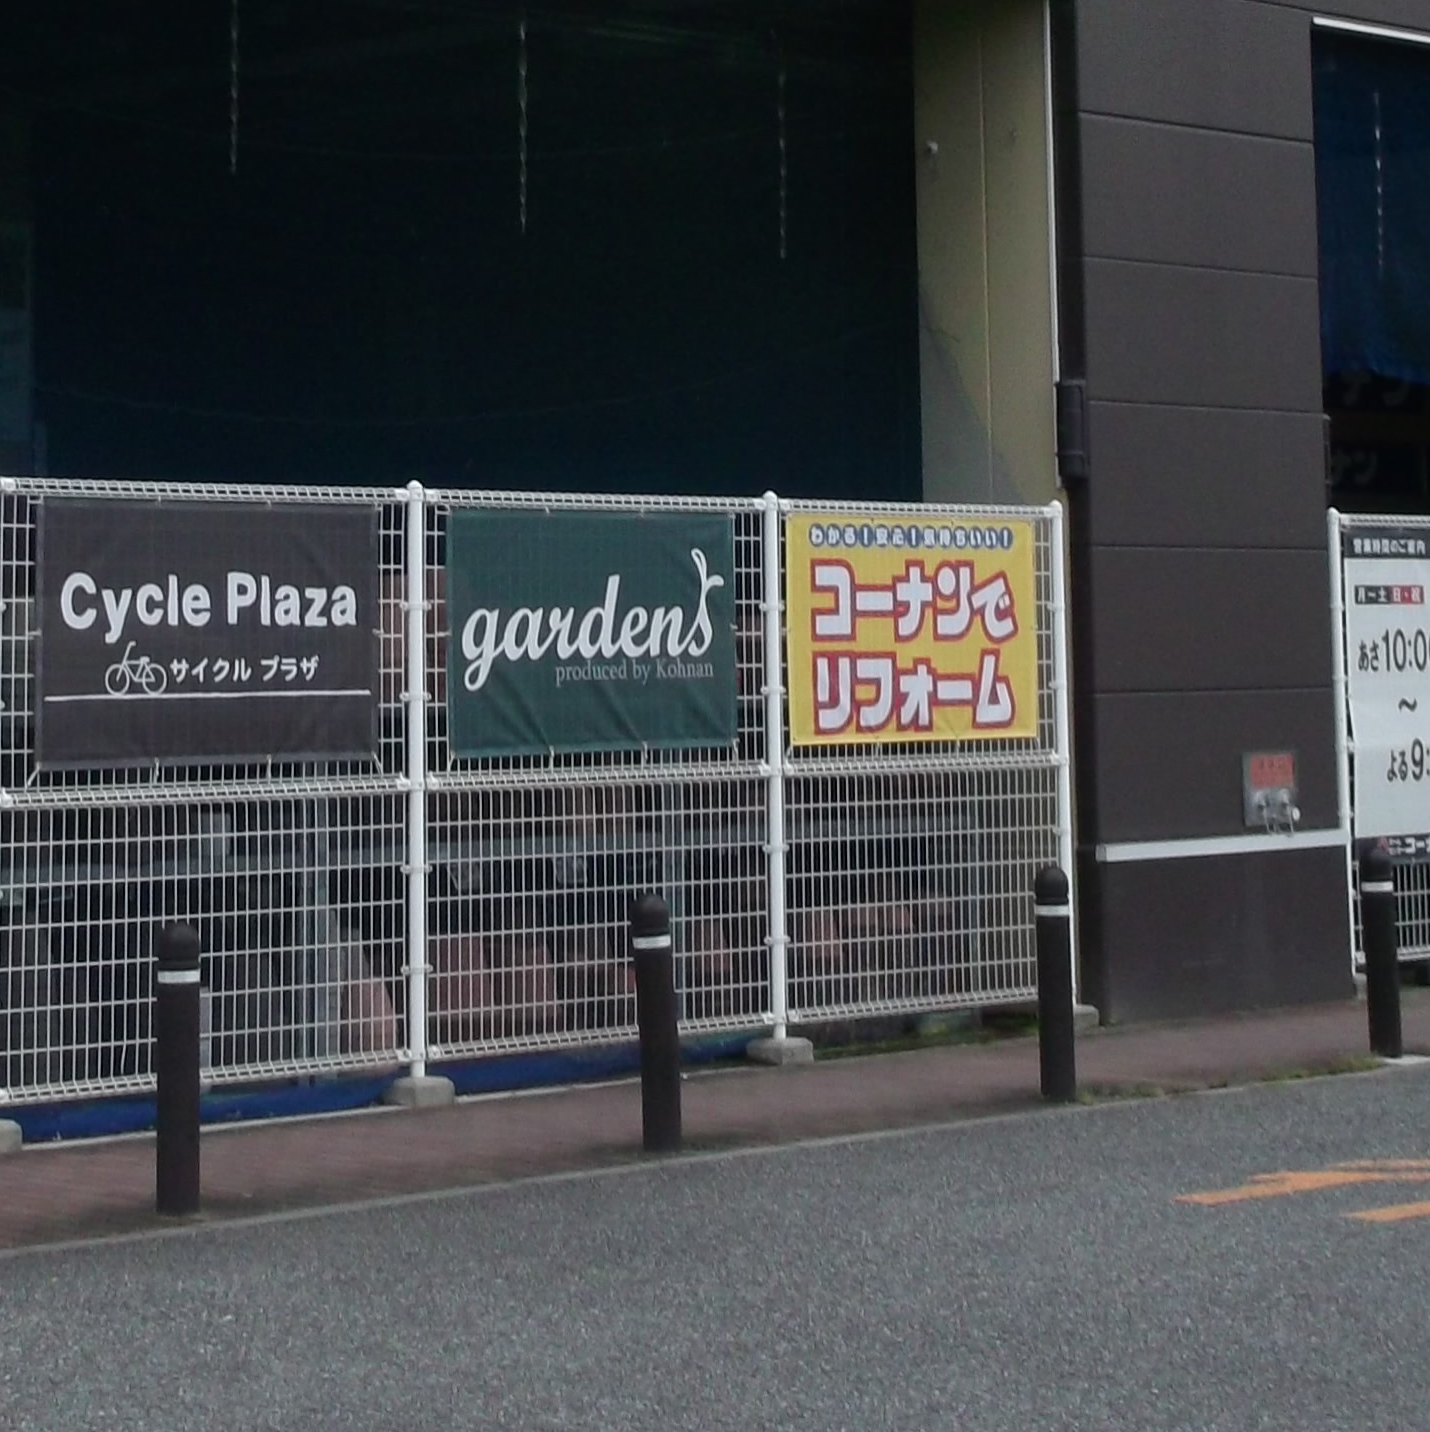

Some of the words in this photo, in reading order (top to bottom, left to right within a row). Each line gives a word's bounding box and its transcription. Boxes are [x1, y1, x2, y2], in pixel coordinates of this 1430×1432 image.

[60, 570, 211, 643] Cycle
[227, 571, 358, 629] Plaza
[461, 547, 725, 692] gardens
[810, 558, 1018, 643] コーナンで
[170, 656, 252, 684] サイクル
[262, 655, 320, 683] プラザ
[555, 659, 628, 688] produced
[632, 658, 651, 685] by
[656, 656, 714, 680] Kohnan
[811, 648, 1016, 735] リフォーム
